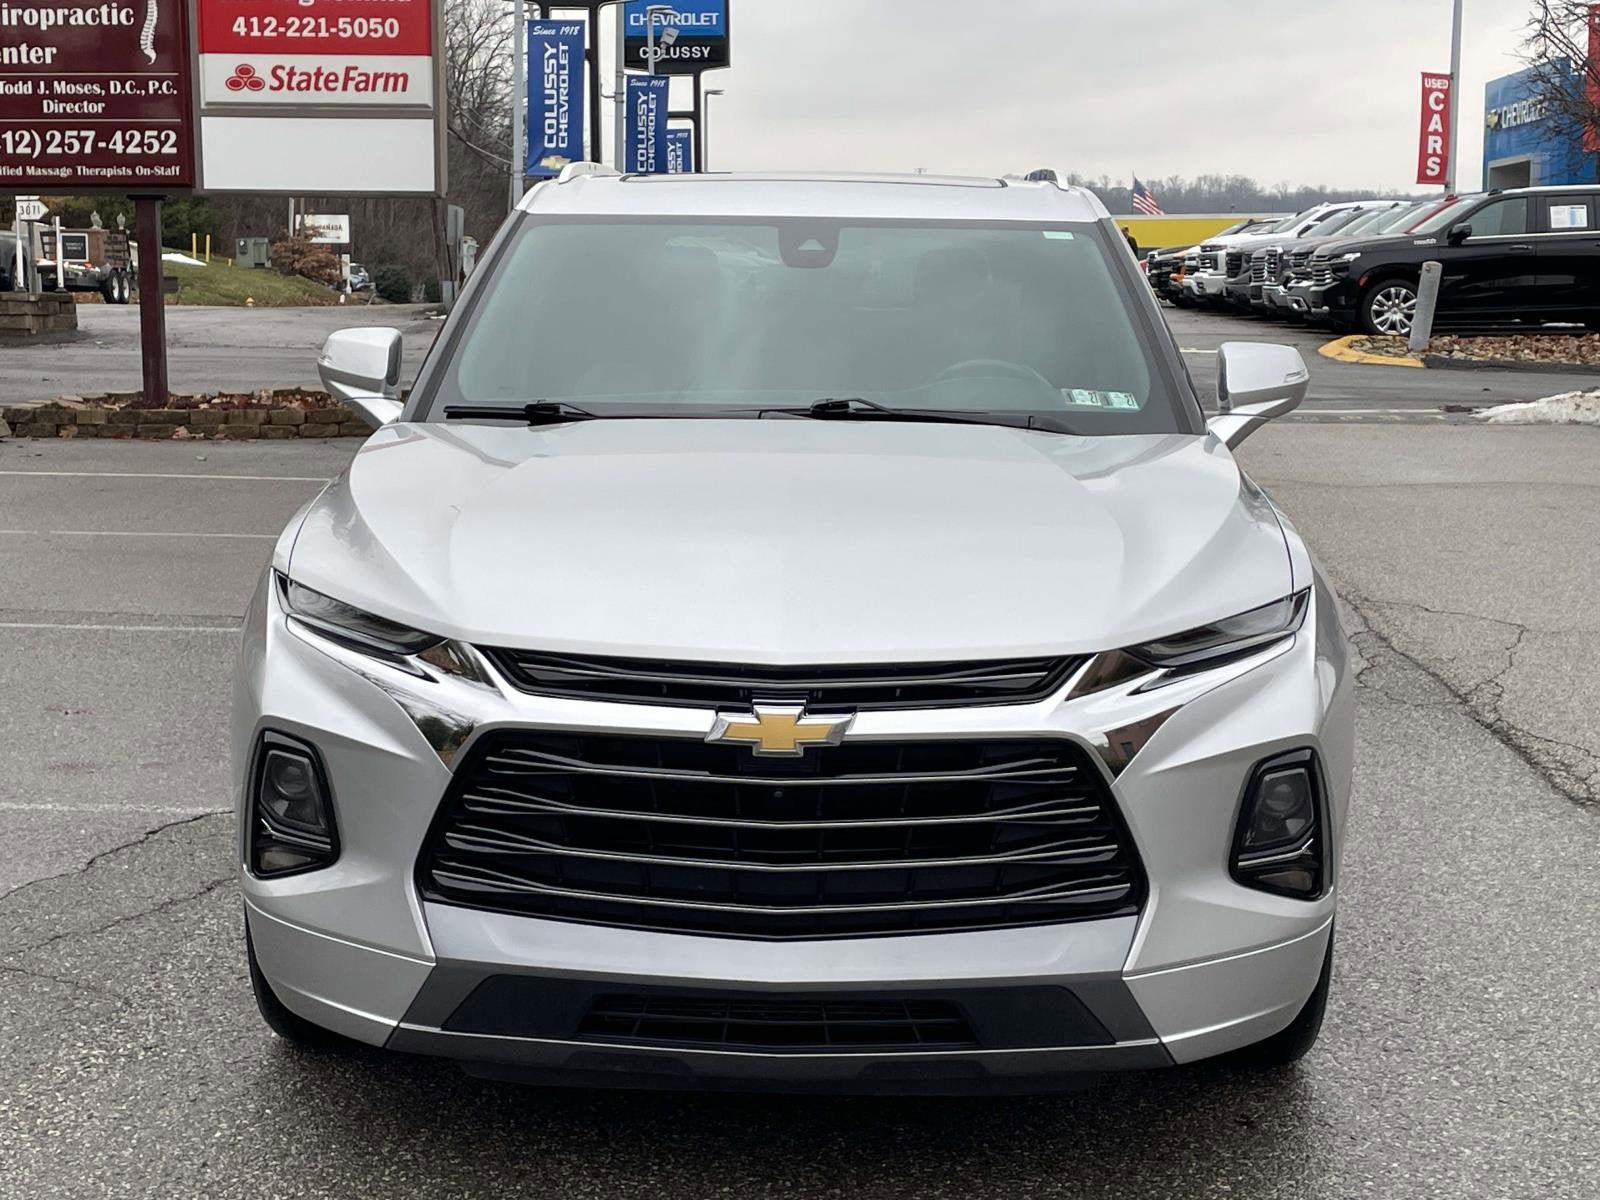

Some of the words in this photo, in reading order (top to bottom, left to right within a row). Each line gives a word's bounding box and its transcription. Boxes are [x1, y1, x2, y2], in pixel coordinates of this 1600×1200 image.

[0, 3, 135, 30] iropractic
[232, 16, 400, 39] 412-221-5050
[630, 12, 720, 26] CHEVROLET
[532, 25, 556, 36] Since
[559, 25, 580, 36] 1918
[0, 42, 57, 65] nter
[639, 46, 711, 59] COLUSSY
[37, 80, 50, 95] J.
[53, 80, 106, 97] Moses,
[109, 80, 146, 96] D.C.,
[148, 80, 178, 95] P.C.
[558, 41, 569, 148] CHEVROLET
[1424, 77, 1448, 89] USED
[42, 99, 106, 114] Director
[544, 42, 557, 149] COLUSSY
[637, 91, 649, 172] COLUSSY
[647, 91, 657, 172] CHEVROLET
[1426, 91, 1445, 176] CARS
[26, 165, 73, 178] Massage
[76, 165, 133, 178] Therapists
[135, 165, 180, 176] On-Staff
